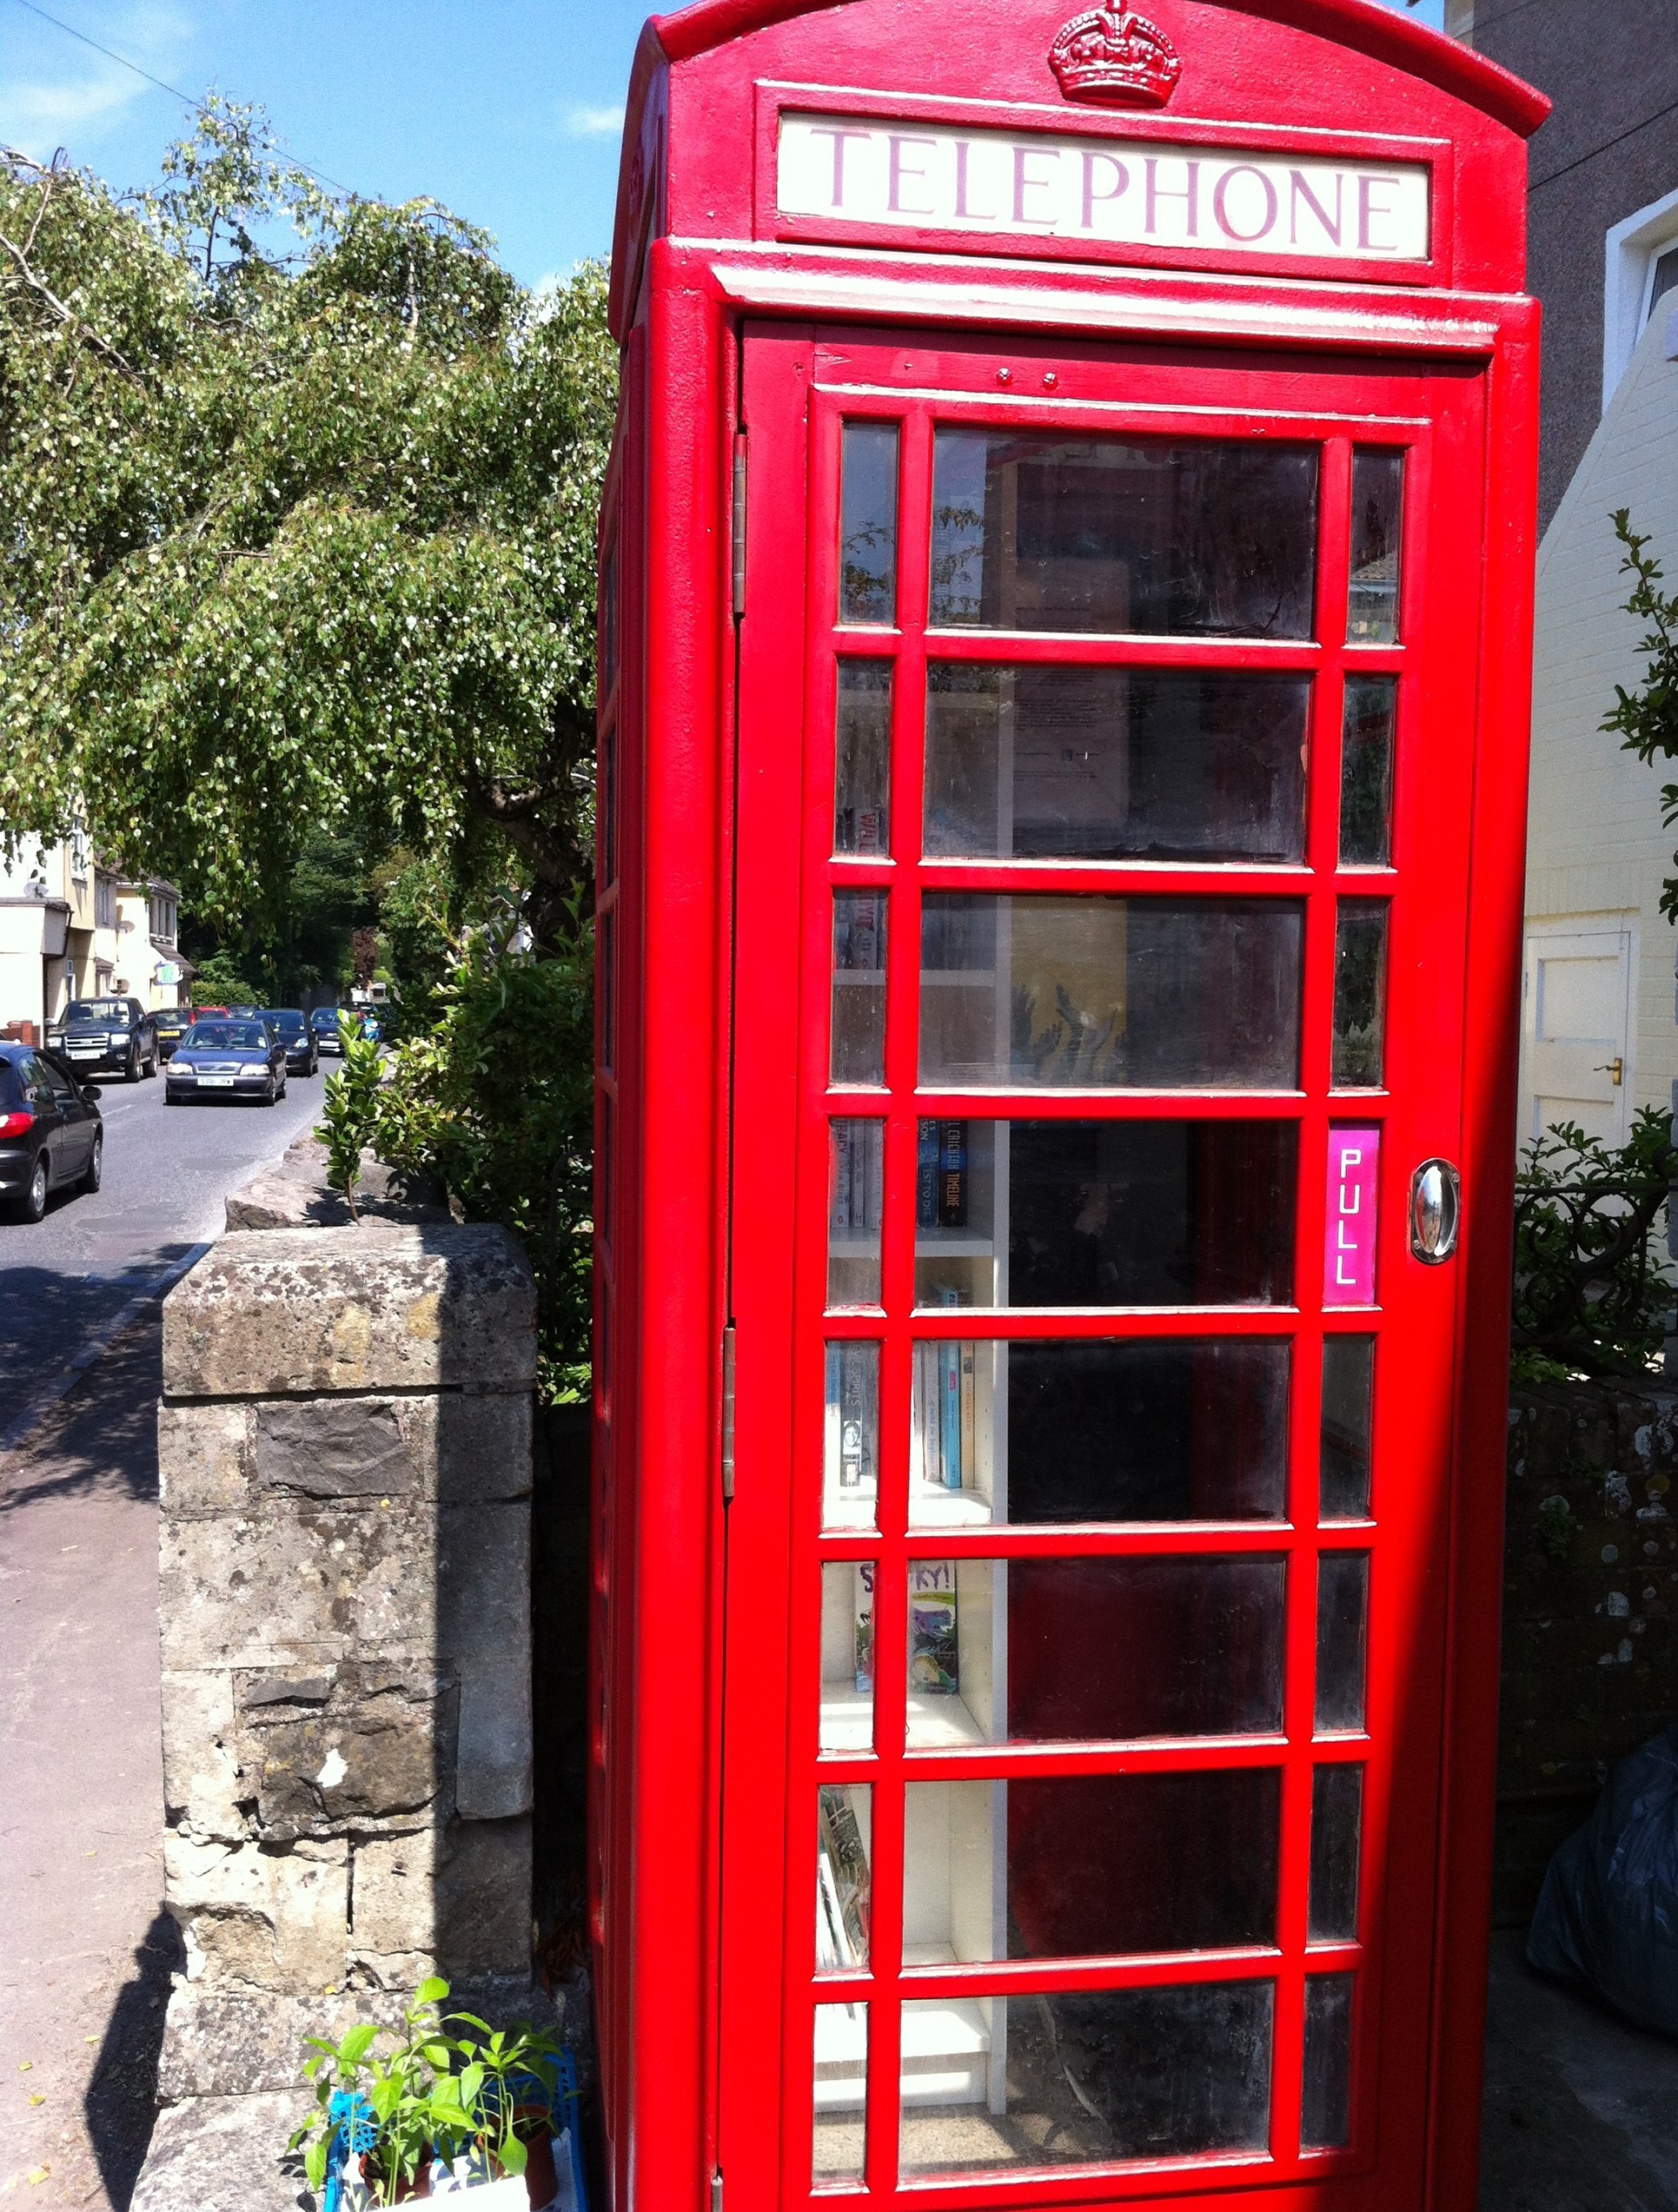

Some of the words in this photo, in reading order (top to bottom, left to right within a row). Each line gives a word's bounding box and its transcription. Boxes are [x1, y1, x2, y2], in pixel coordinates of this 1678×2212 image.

[810, 129, 1400, 252] TELEPHONE
[946, 1173, 960, 1207] TIMELINE
[1336, 1149, 1362, 1284] PULL
[851, 1368, 861, 1406] SPIRITS
[859, 1562, 950, 1593] SKY!
